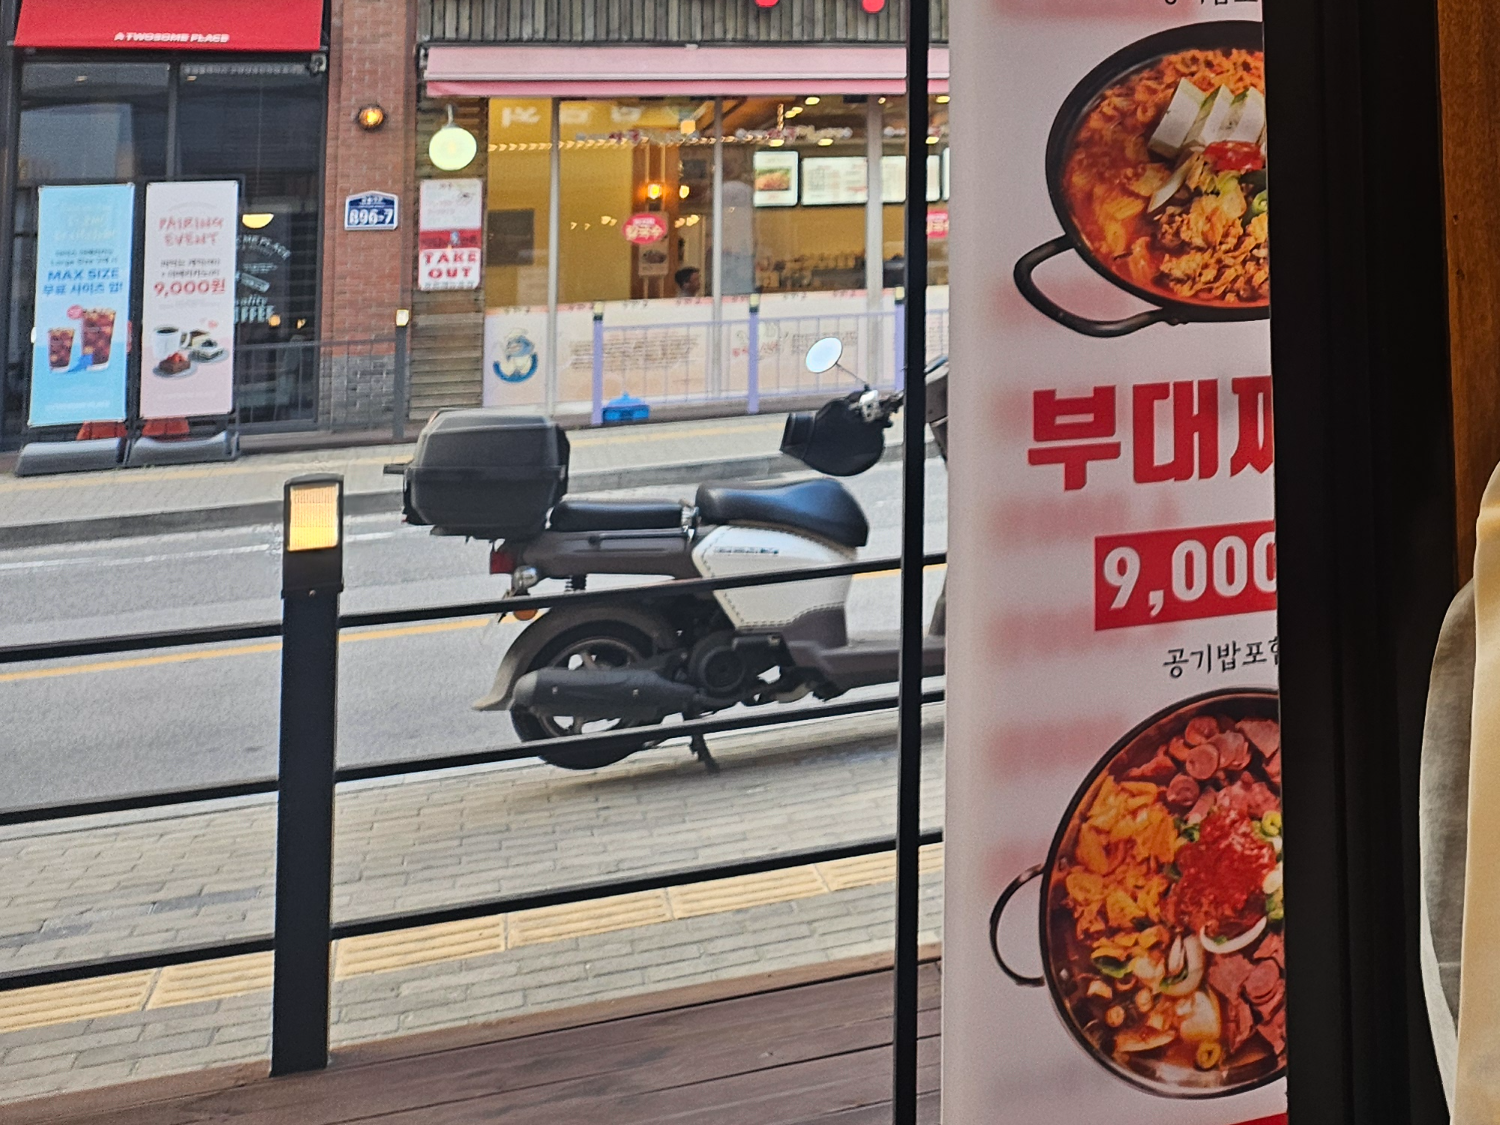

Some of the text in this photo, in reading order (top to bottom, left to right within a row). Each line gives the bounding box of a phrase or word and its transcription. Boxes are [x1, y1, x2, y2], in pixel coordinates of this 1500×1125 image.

[349, 208, 394, 226] 896-7
[164, 231, 220, 247] EVENT
[424, 251, 477, 264] TAKE
[47, 267, 120, 281] MAX SIZE
[428, 268, 472, 279] OUT
